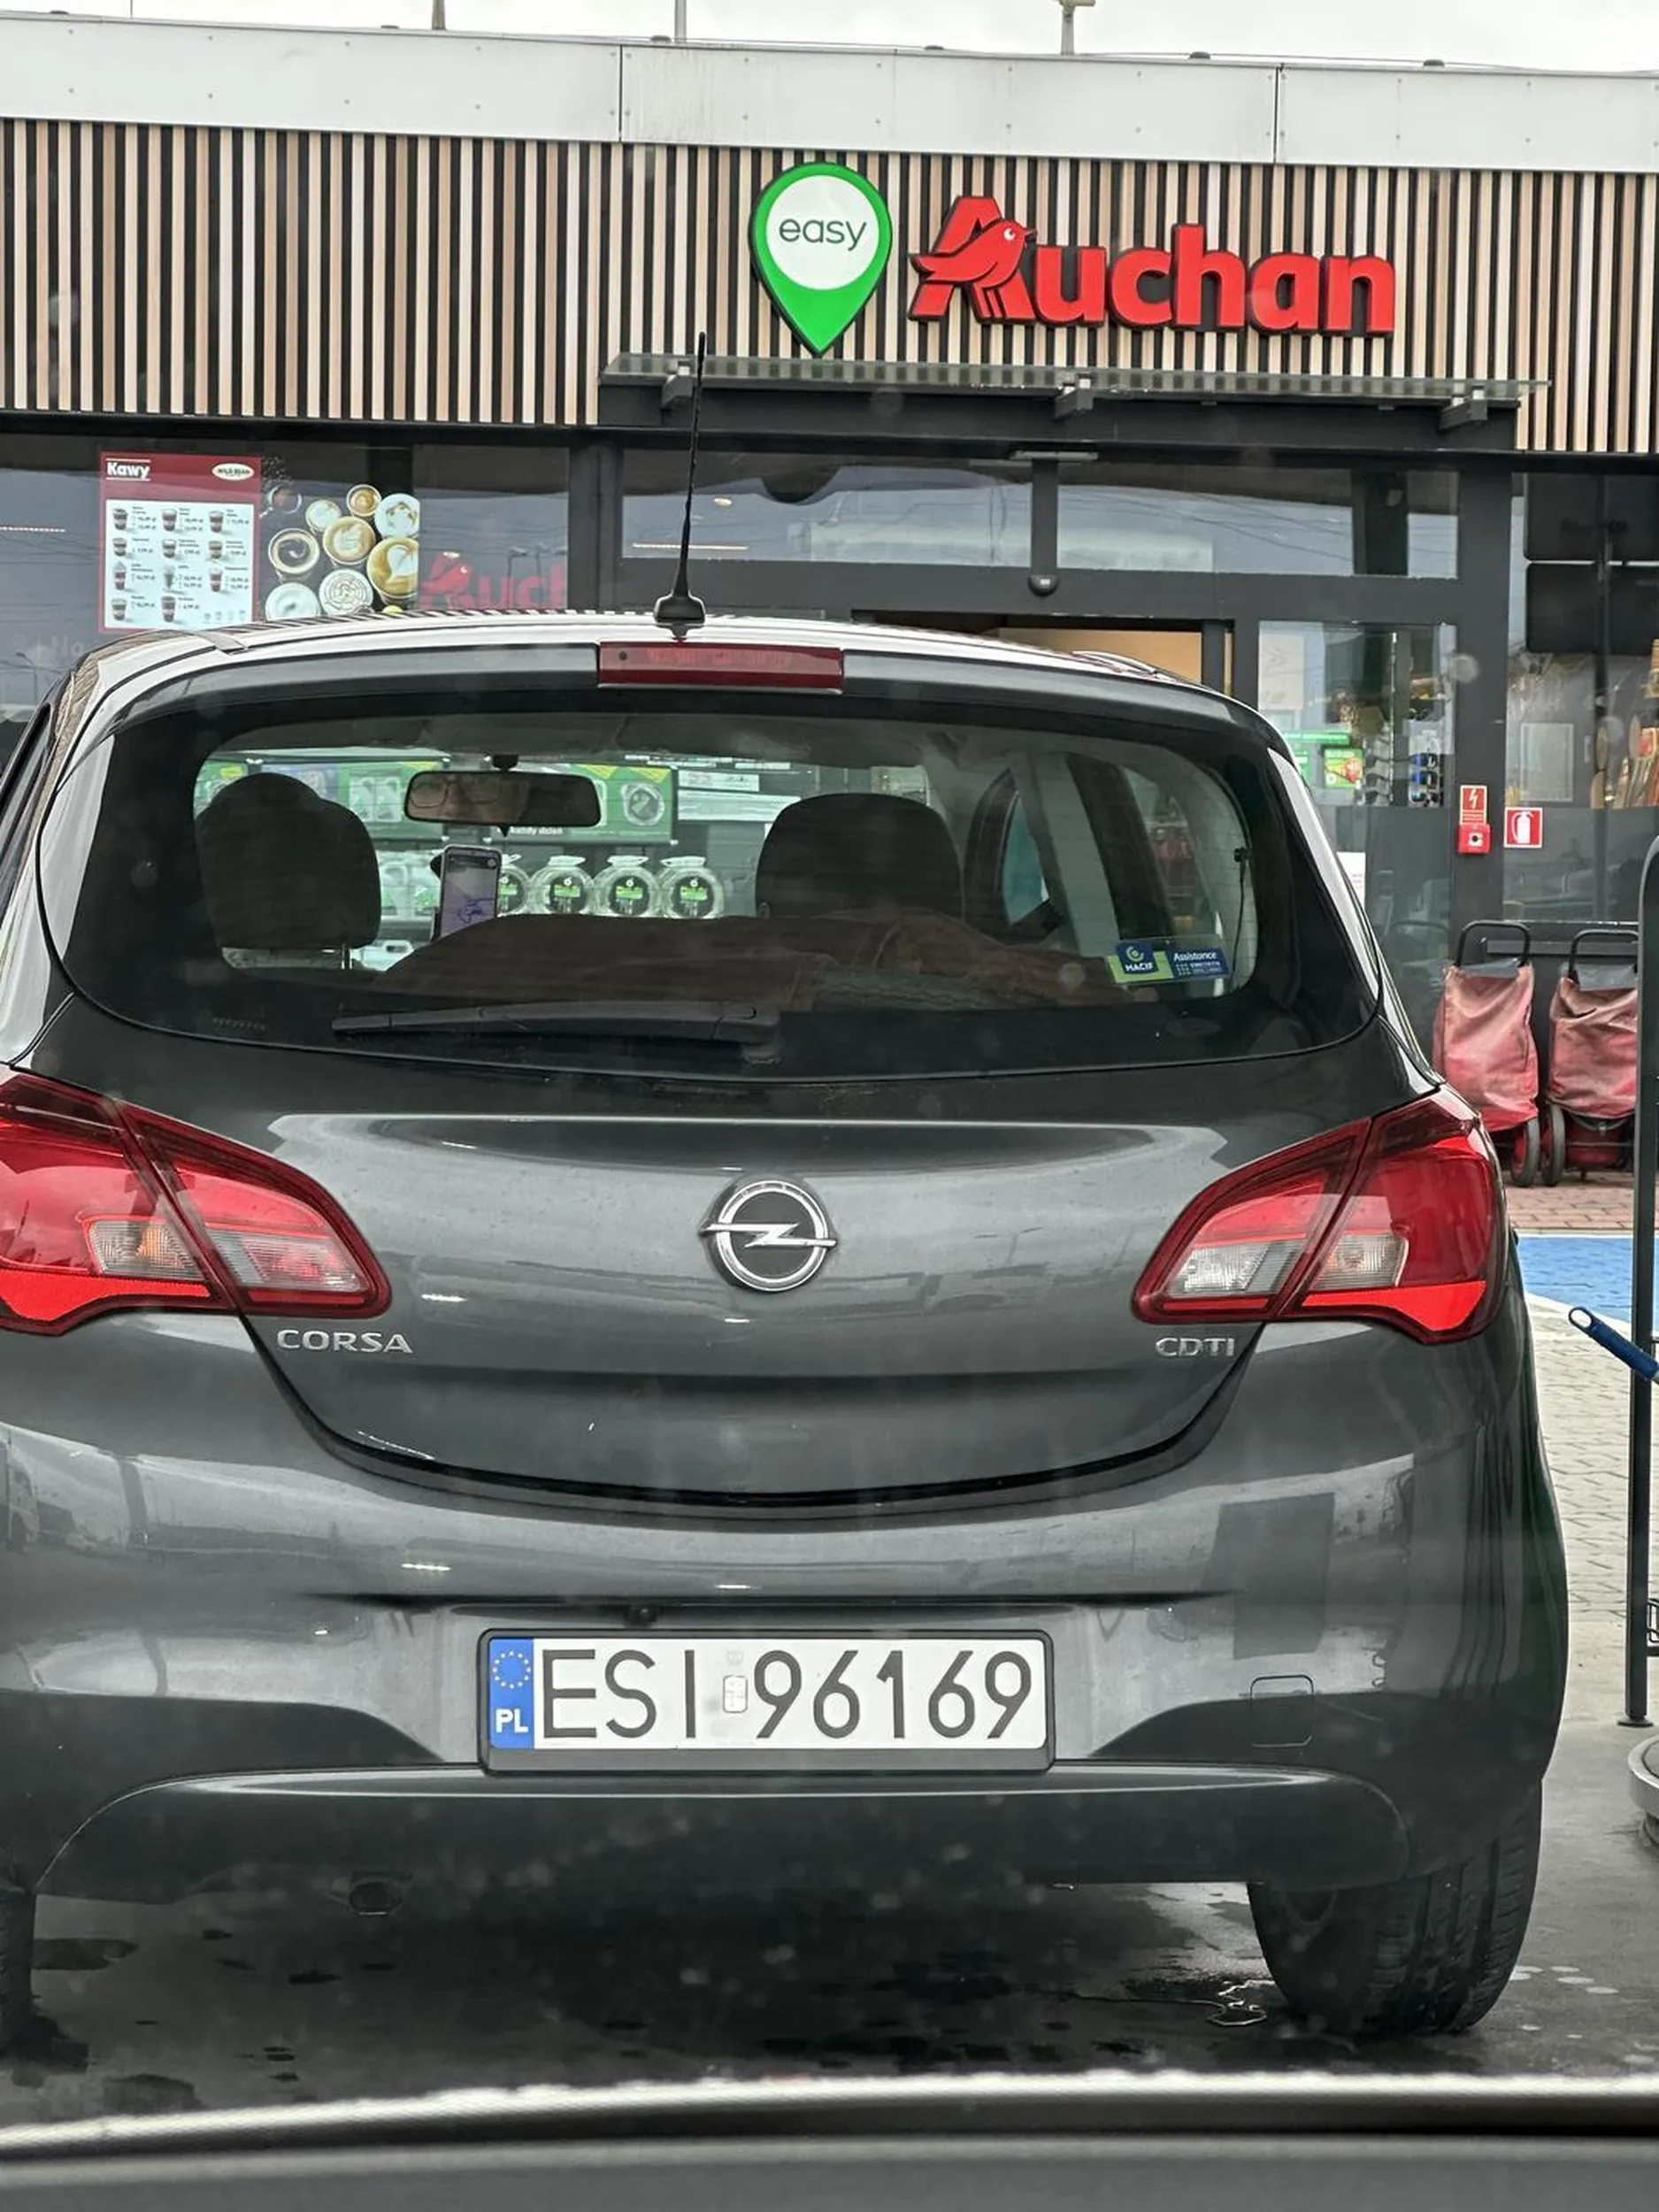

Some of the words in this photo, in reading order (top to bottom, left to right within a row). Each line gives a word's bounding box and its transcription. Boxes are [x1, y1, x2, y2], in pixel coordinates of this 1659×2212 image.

[779, 215, 868, 250] easy
[909, 195, 1396, 336] Auchan
[106, 461, 150, 480] Kawy
[1125, 962, 1153, 972] MACIF
[1173, 950, 1217, 962] Assistance
[277, 1329, 413, 1354] CORSA
[1156, 1337, 1234, 1356] CDTI
[542, 1648, 696, 1739] ESI
[754, 1648, 1033, 1739] 96169
[495, 1708, 529, 1734] PL
